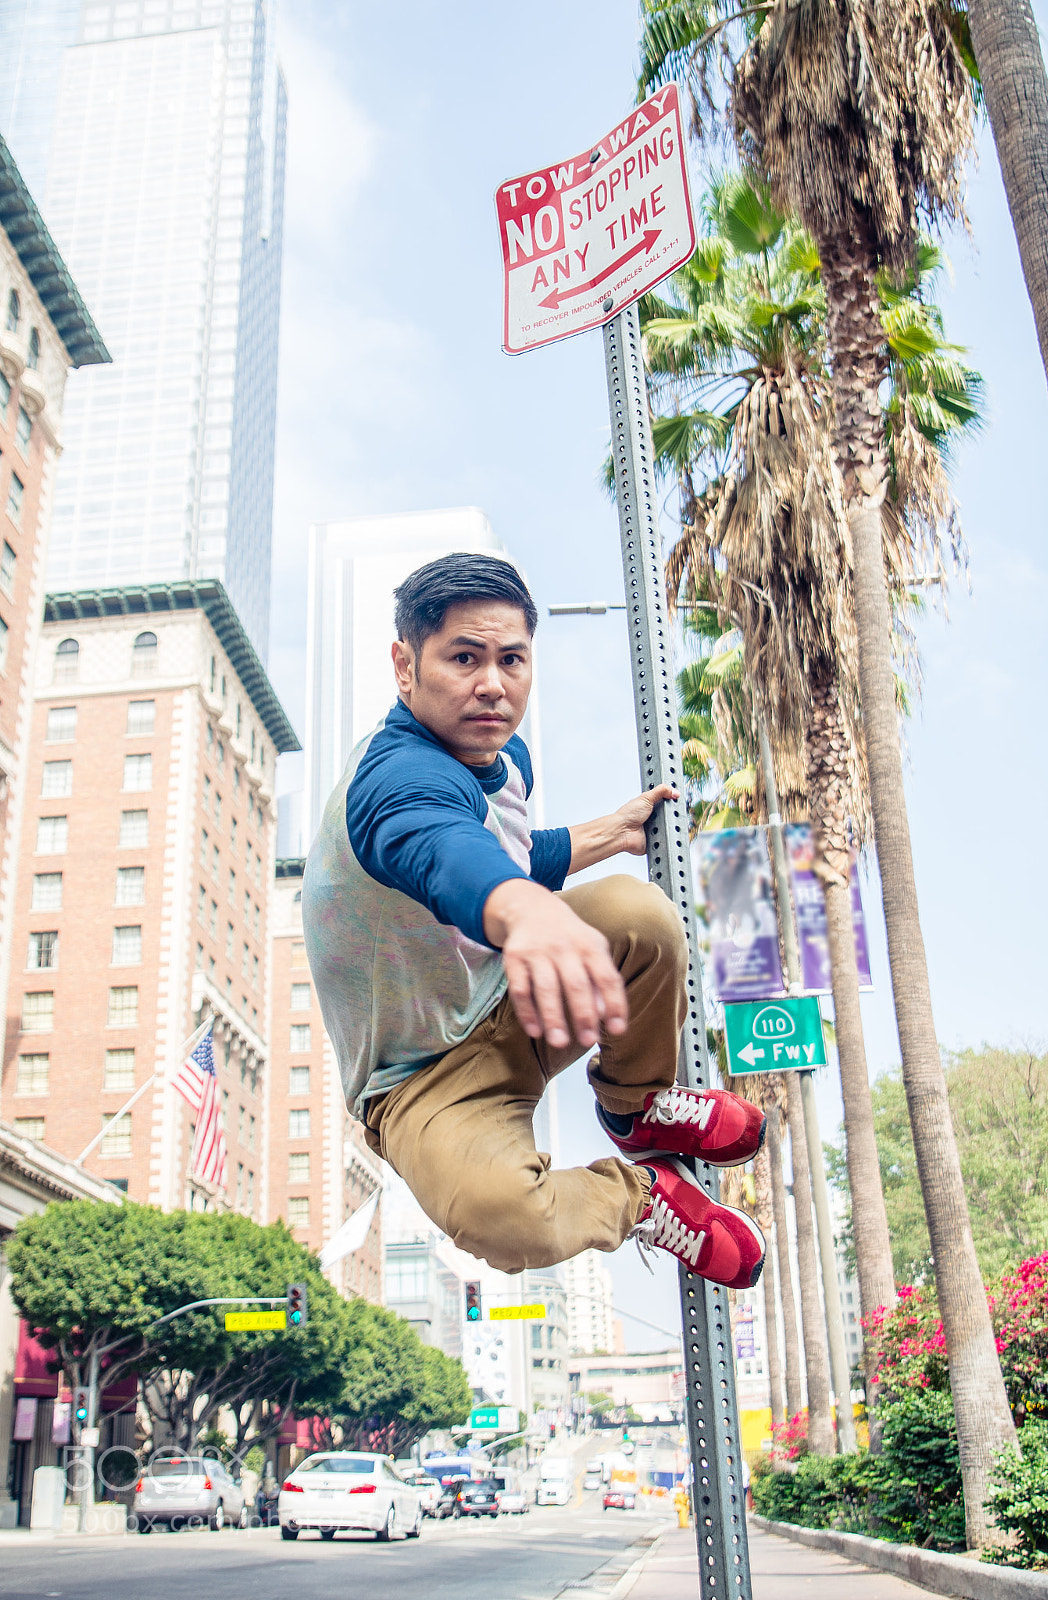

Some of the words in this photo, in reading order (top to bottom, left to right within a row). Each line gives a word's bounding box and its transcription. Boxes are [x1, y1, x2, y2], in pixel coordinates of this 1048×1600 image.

[502, 88, 670, 207] TOW-AWAY
[505, 205, 560, 265] NO
[569, 126, 674, 231] STOPPING
[521, 324, 531, 333] TO
[533, 311, 569, 328] RECOVER
[571, 289, 612, 315] IMPOUNDED
[612, 265, 643, 292] VEHICLES
[644, 252, 661, 268] CALL
[662, 238, 679, 254] 3-1-1
[530, 241, 590, 293] ANY
[605, 184, 666, 250] TIME
[761, 1017, 787, 1033] 110
[772, 1042, 816, 1063] Fwy
